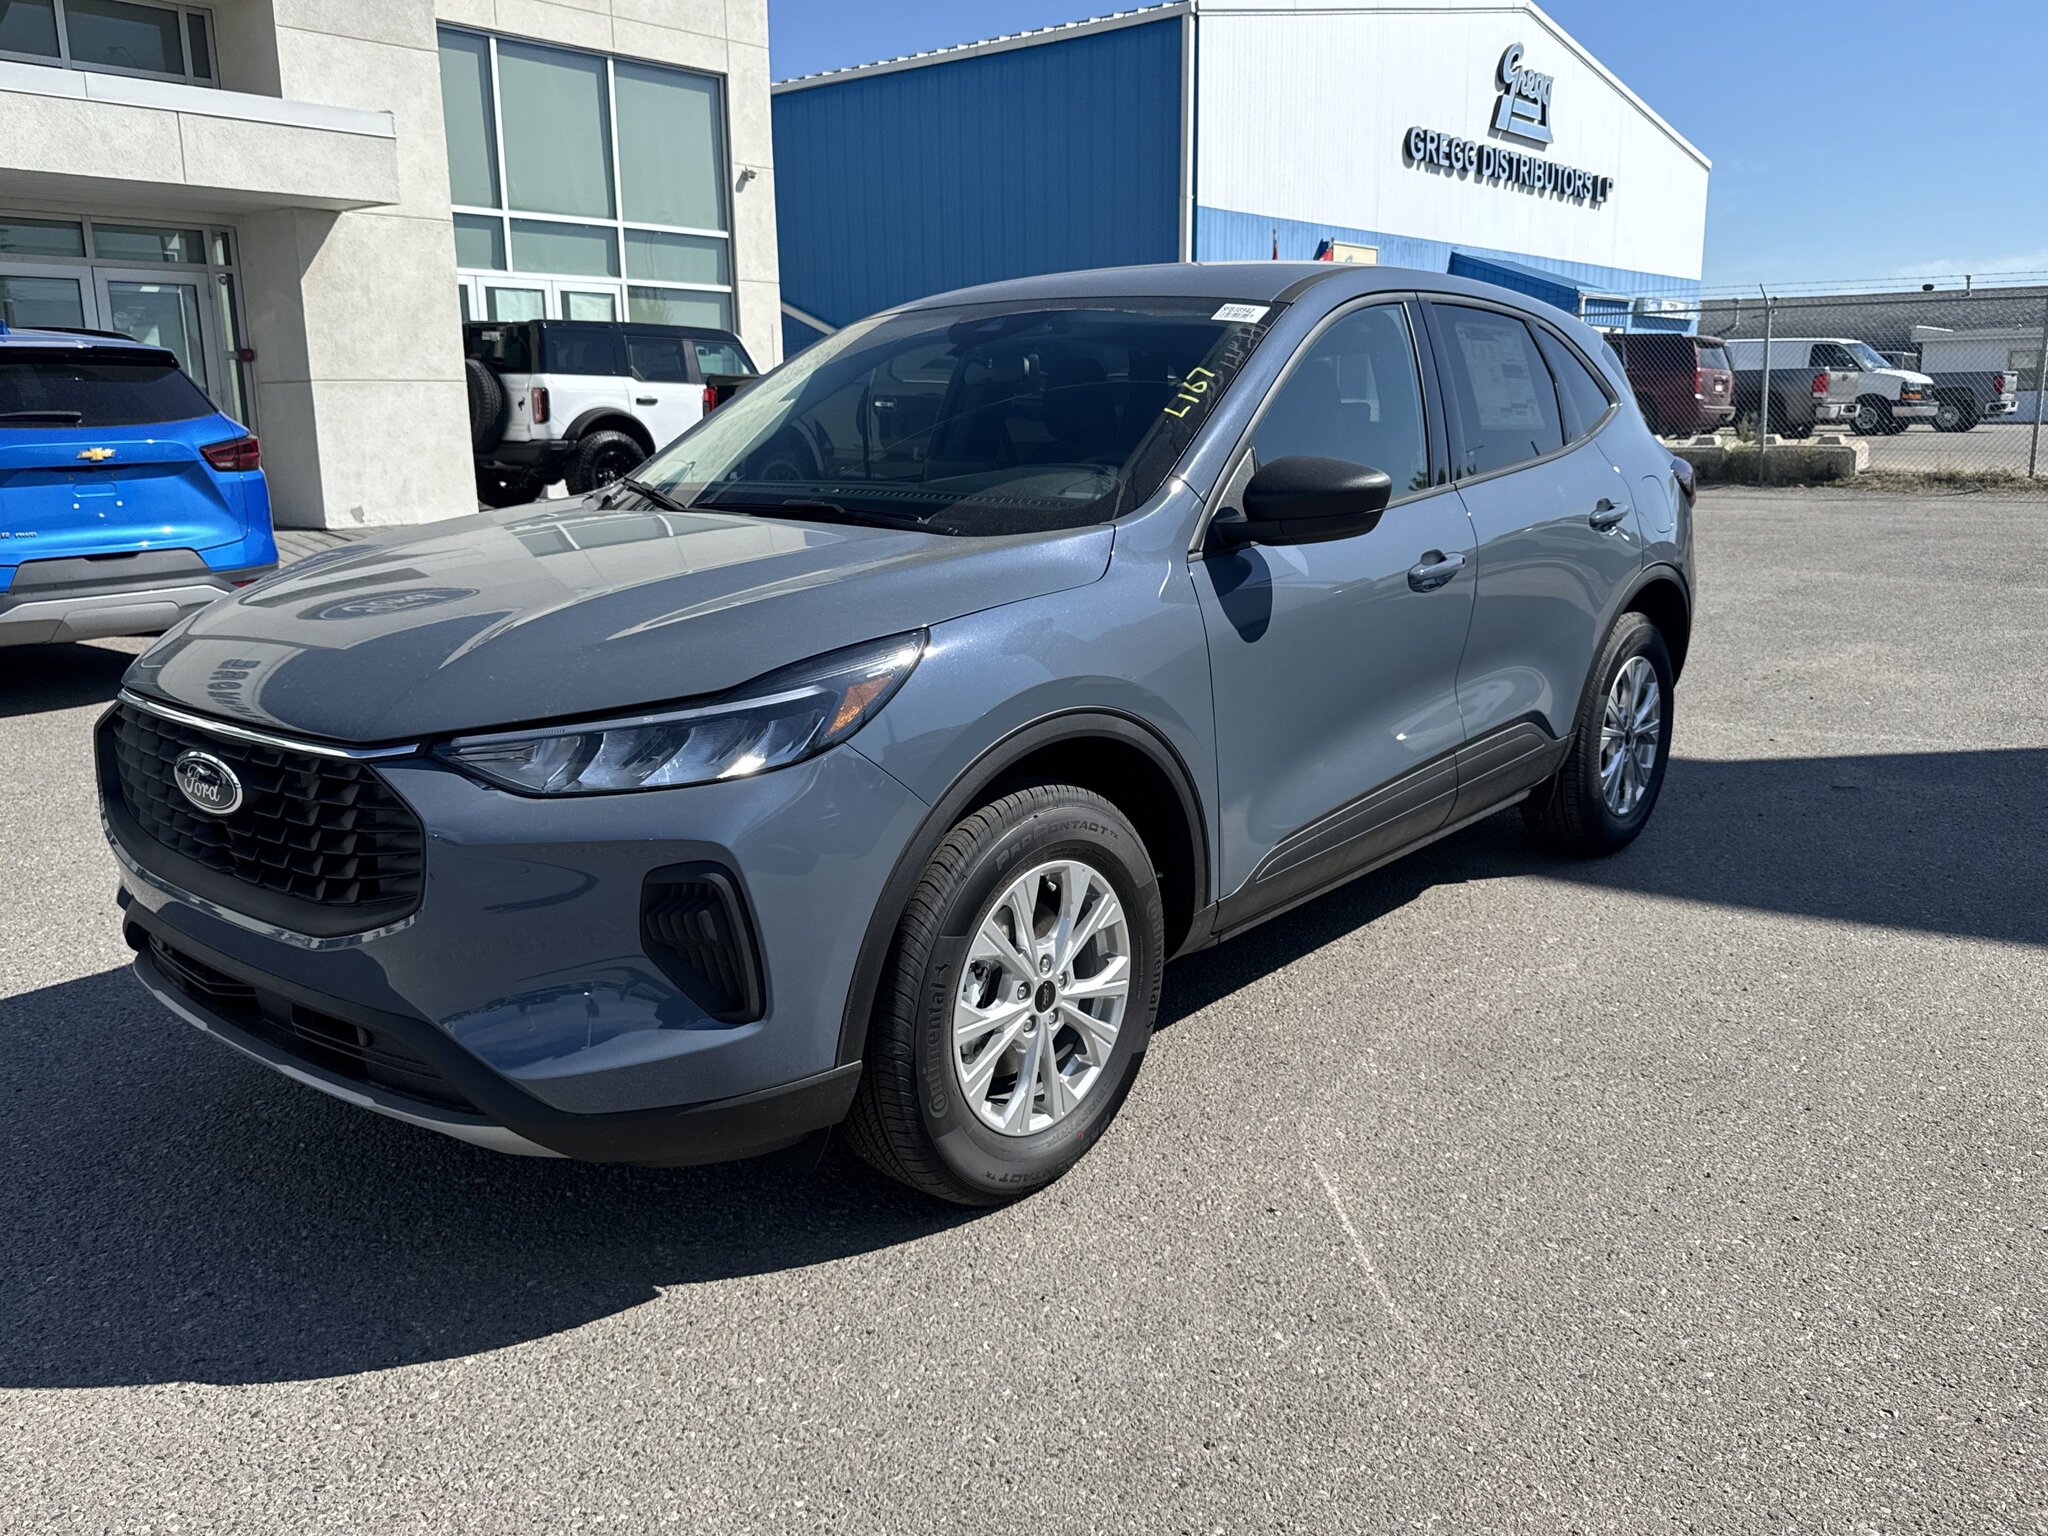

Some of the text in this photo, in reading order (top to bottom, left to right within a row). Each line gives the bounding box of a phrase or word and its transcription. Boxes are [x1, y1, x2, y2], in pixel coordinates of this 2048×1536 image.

[1406, 126, 1614, 203] GREGG DISTRIBUTORS LP
[184, 763, 221, 802] Ford
[925, 982, 952, 1119] Continental
